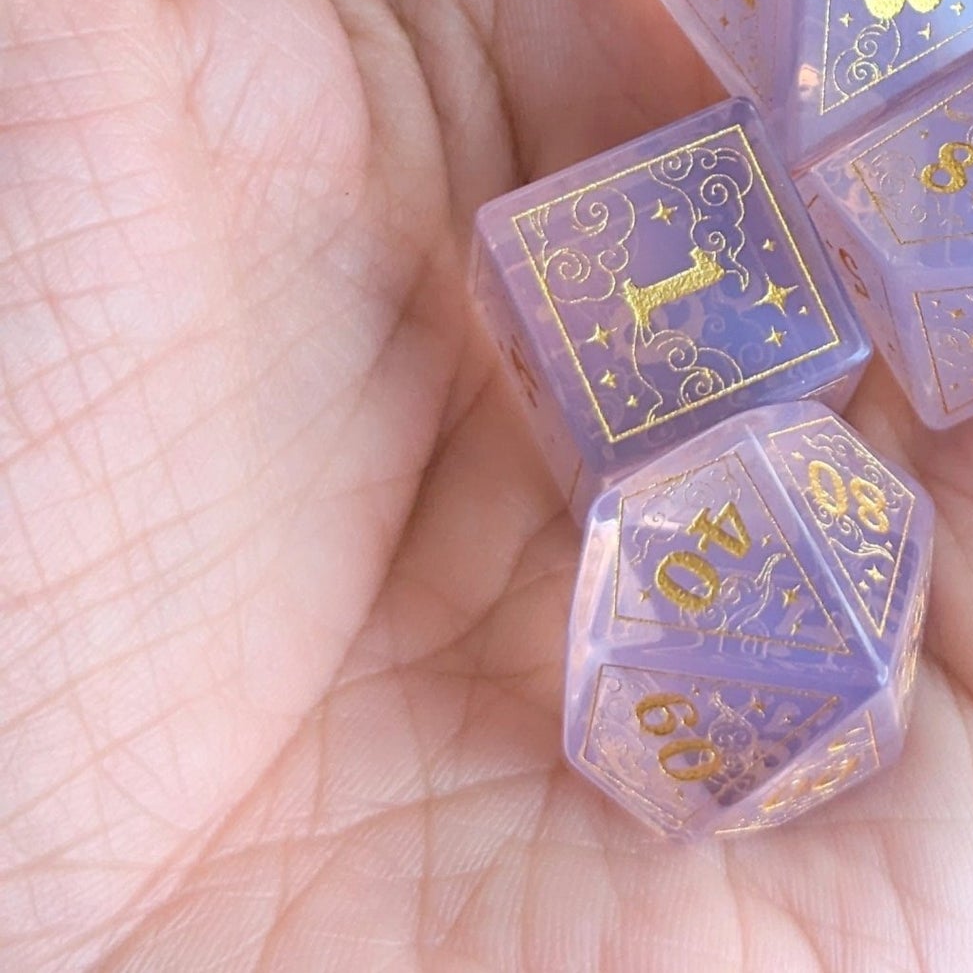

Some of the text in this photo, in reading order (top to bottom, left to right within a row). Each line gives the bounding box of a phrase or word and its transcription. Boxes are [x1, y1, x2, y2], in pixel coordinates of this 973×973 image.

[622, 245, 726, 327] 1
[808, 459, 891, 535] 80
[654, 500, 754, 614] 40
